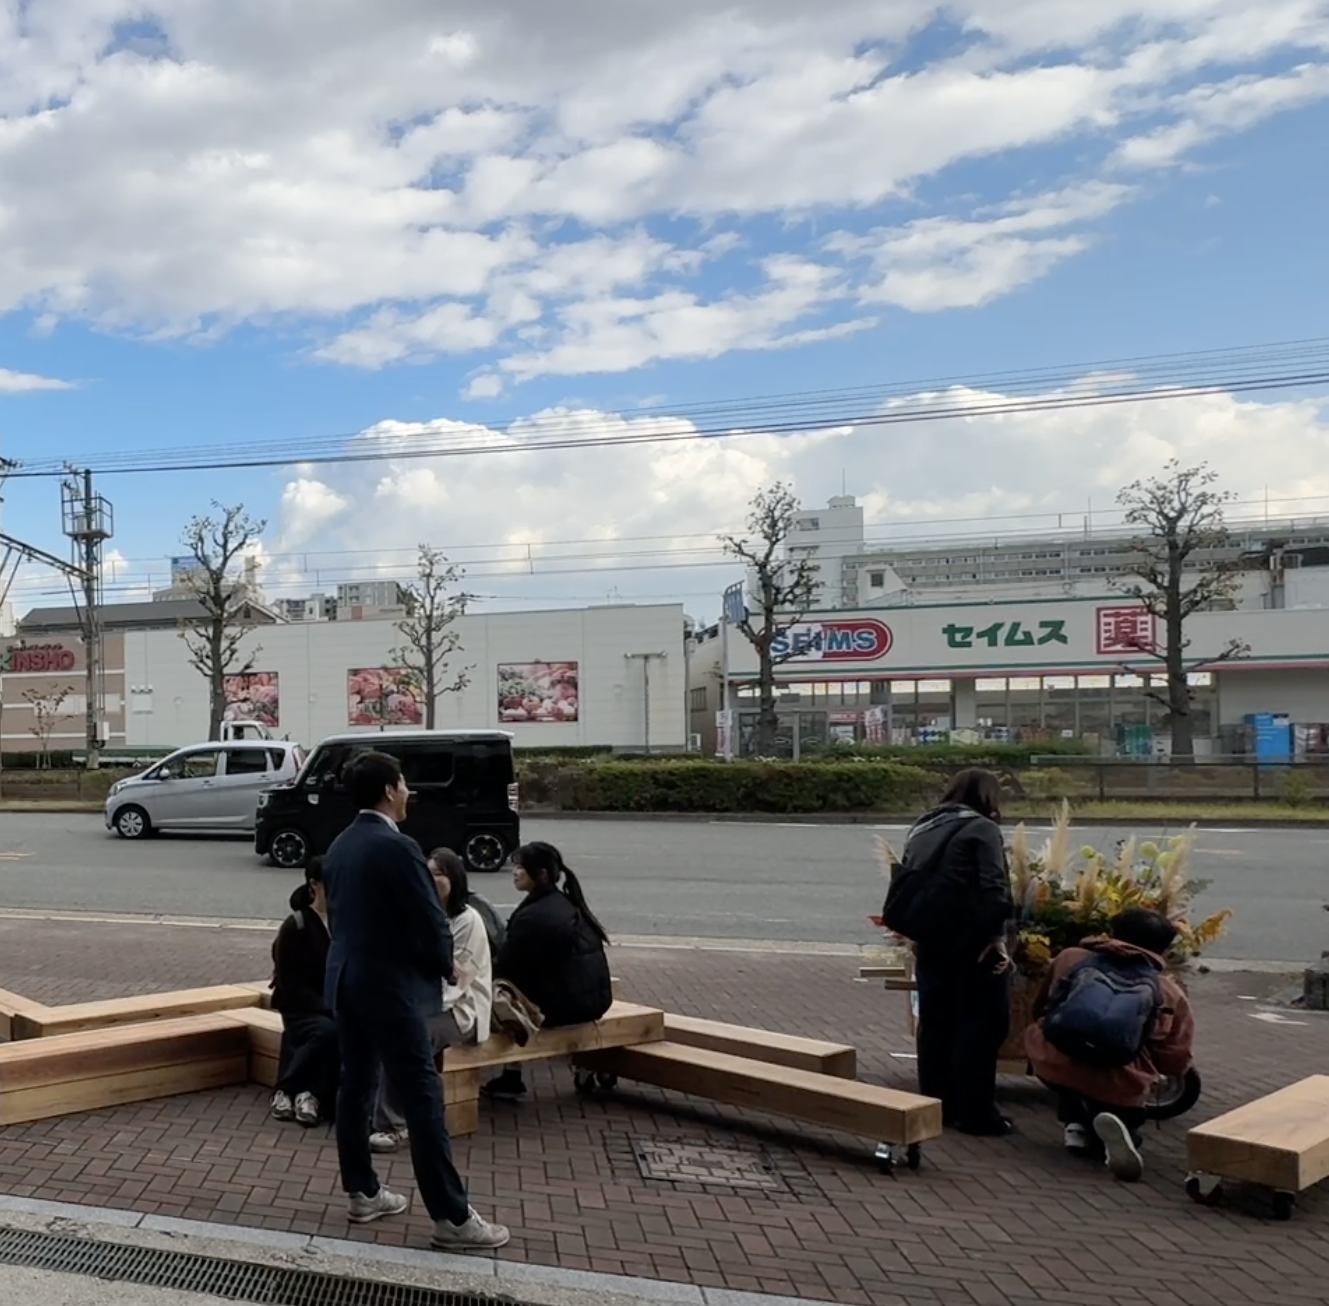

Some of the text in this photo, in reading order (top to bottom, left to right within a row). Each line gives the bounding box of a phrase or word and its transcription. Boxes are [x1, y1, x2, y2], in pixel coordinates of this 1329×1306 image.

[942, 620, 1068, 648] セイムス
[1102, 609, 1150, 650] 薬
[0, 649, 75, 672] KINSHO
